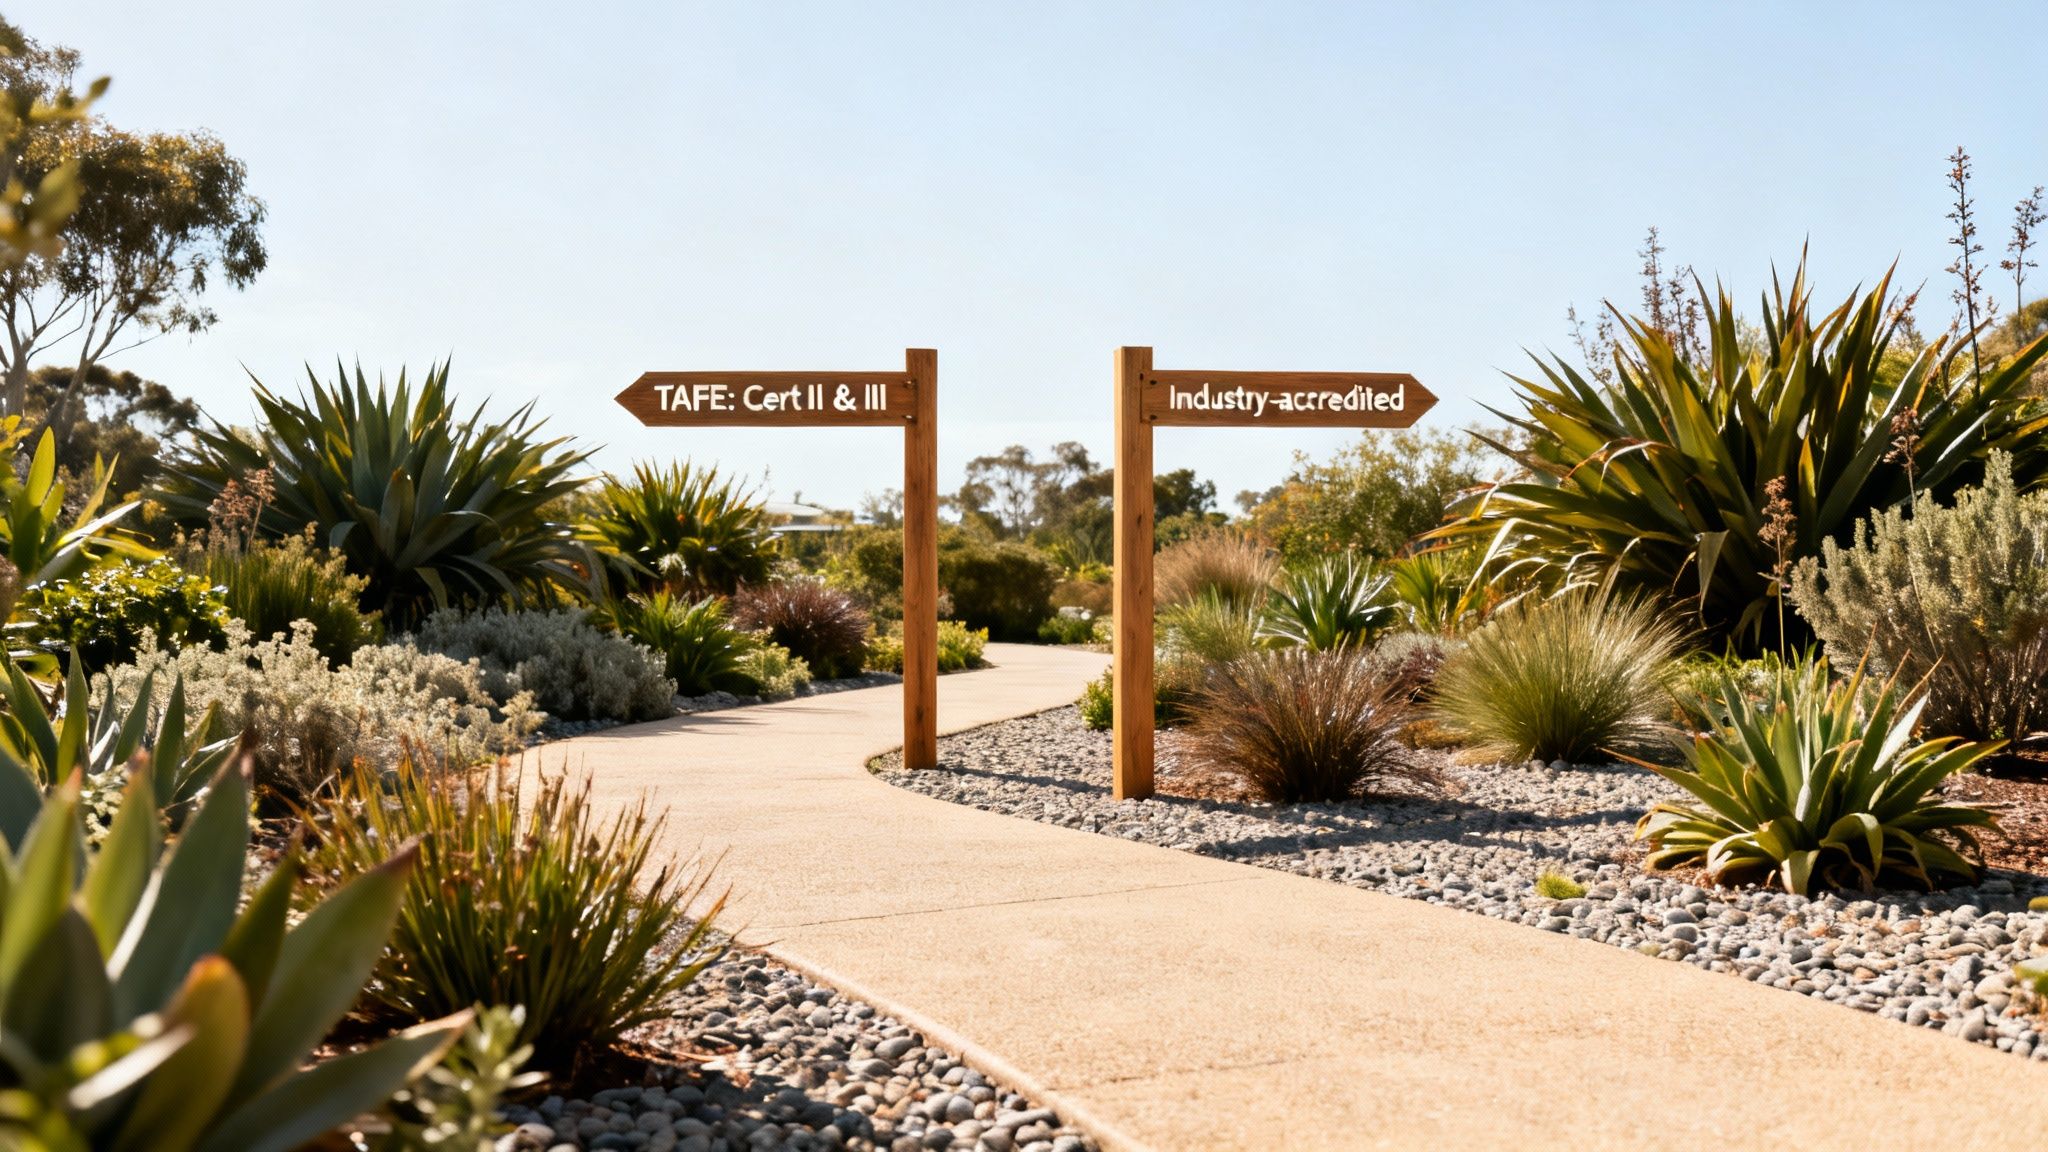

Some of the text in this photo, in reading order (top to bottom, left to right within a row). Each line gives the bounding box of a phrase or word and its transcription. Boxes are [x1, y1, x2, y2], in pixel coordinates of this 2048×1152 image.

[653, 383, 887, 412] TAFE: Cert II & III
[1169, 382, 1405, 417] Industry-accredited
